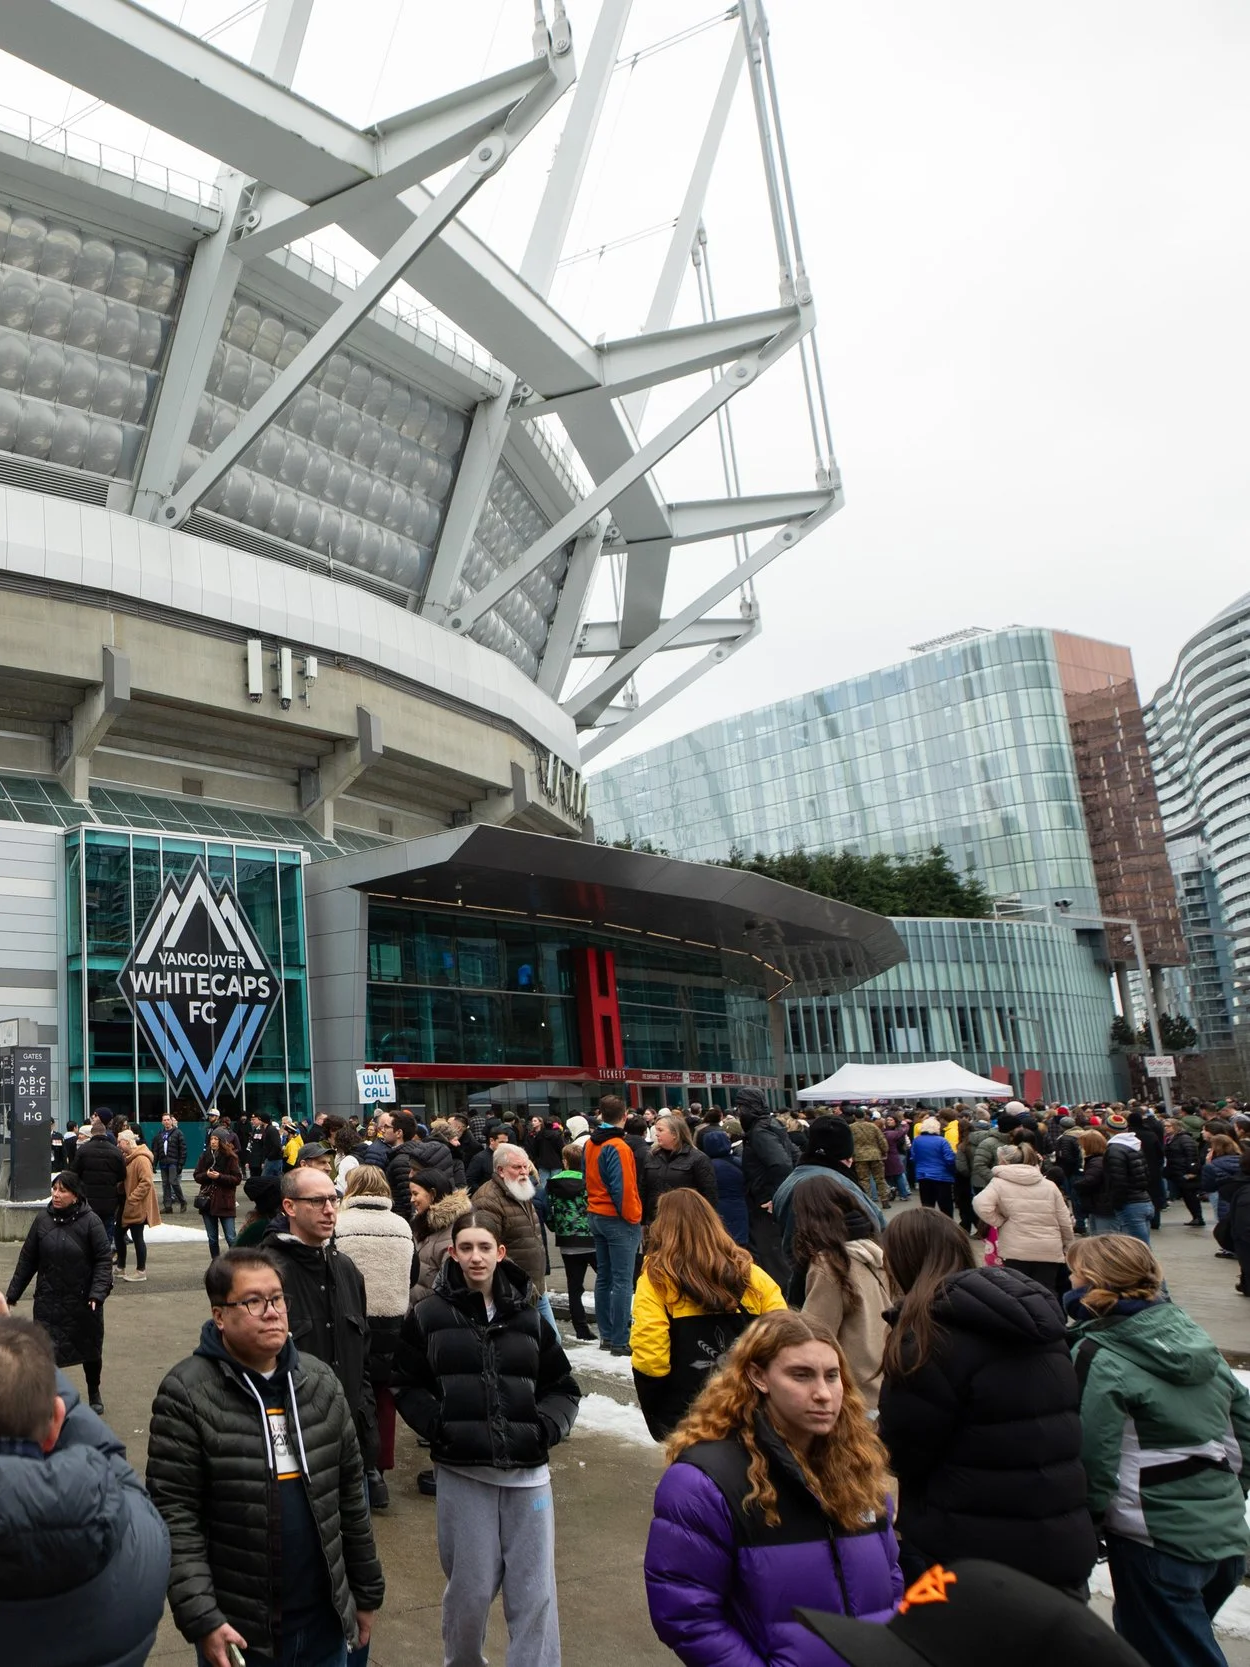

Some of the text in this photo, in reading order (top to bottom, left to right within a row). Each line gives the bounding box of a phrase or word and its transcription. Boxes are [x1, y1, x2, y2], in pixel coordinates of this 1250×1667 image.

[158, 952, 246, 969] VANCOUVER
[129, 970, 271, 999] WHITECAPS
[189, 1001, 218, 1024] FC
[362, 1074, 390, 1085] WILL
[599, 1069, 626, 1079] TICKETS
[364, 1087, 391, 1098] CALL
